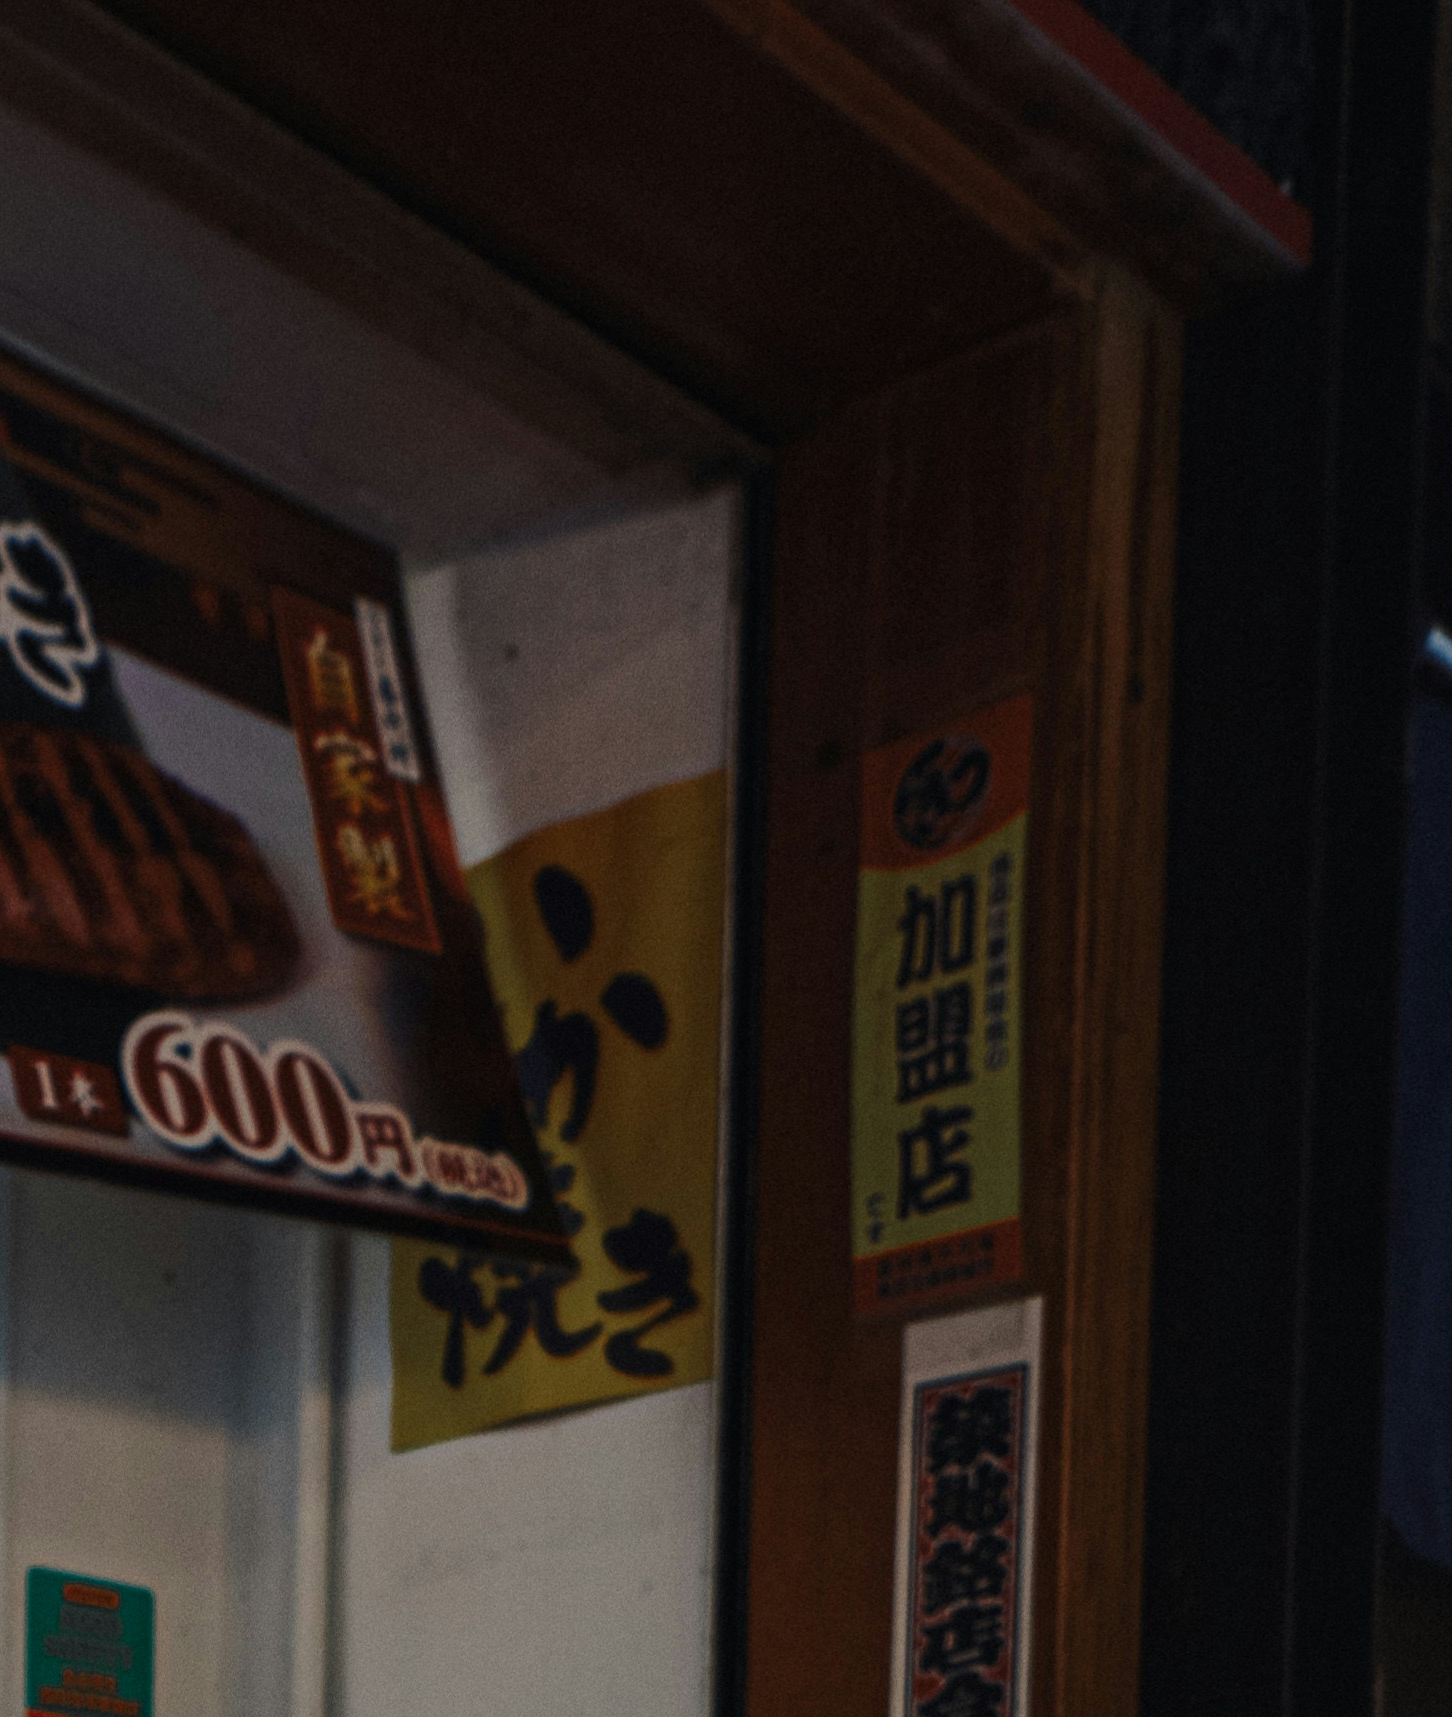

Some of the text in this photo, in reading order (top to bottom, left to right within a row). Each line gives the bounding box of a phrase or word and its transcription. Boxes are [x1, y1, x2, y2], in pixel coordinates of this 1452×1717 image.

[305, 626, 416, 920] 自家製
[896, 873, 976, 1221] 加盟店
